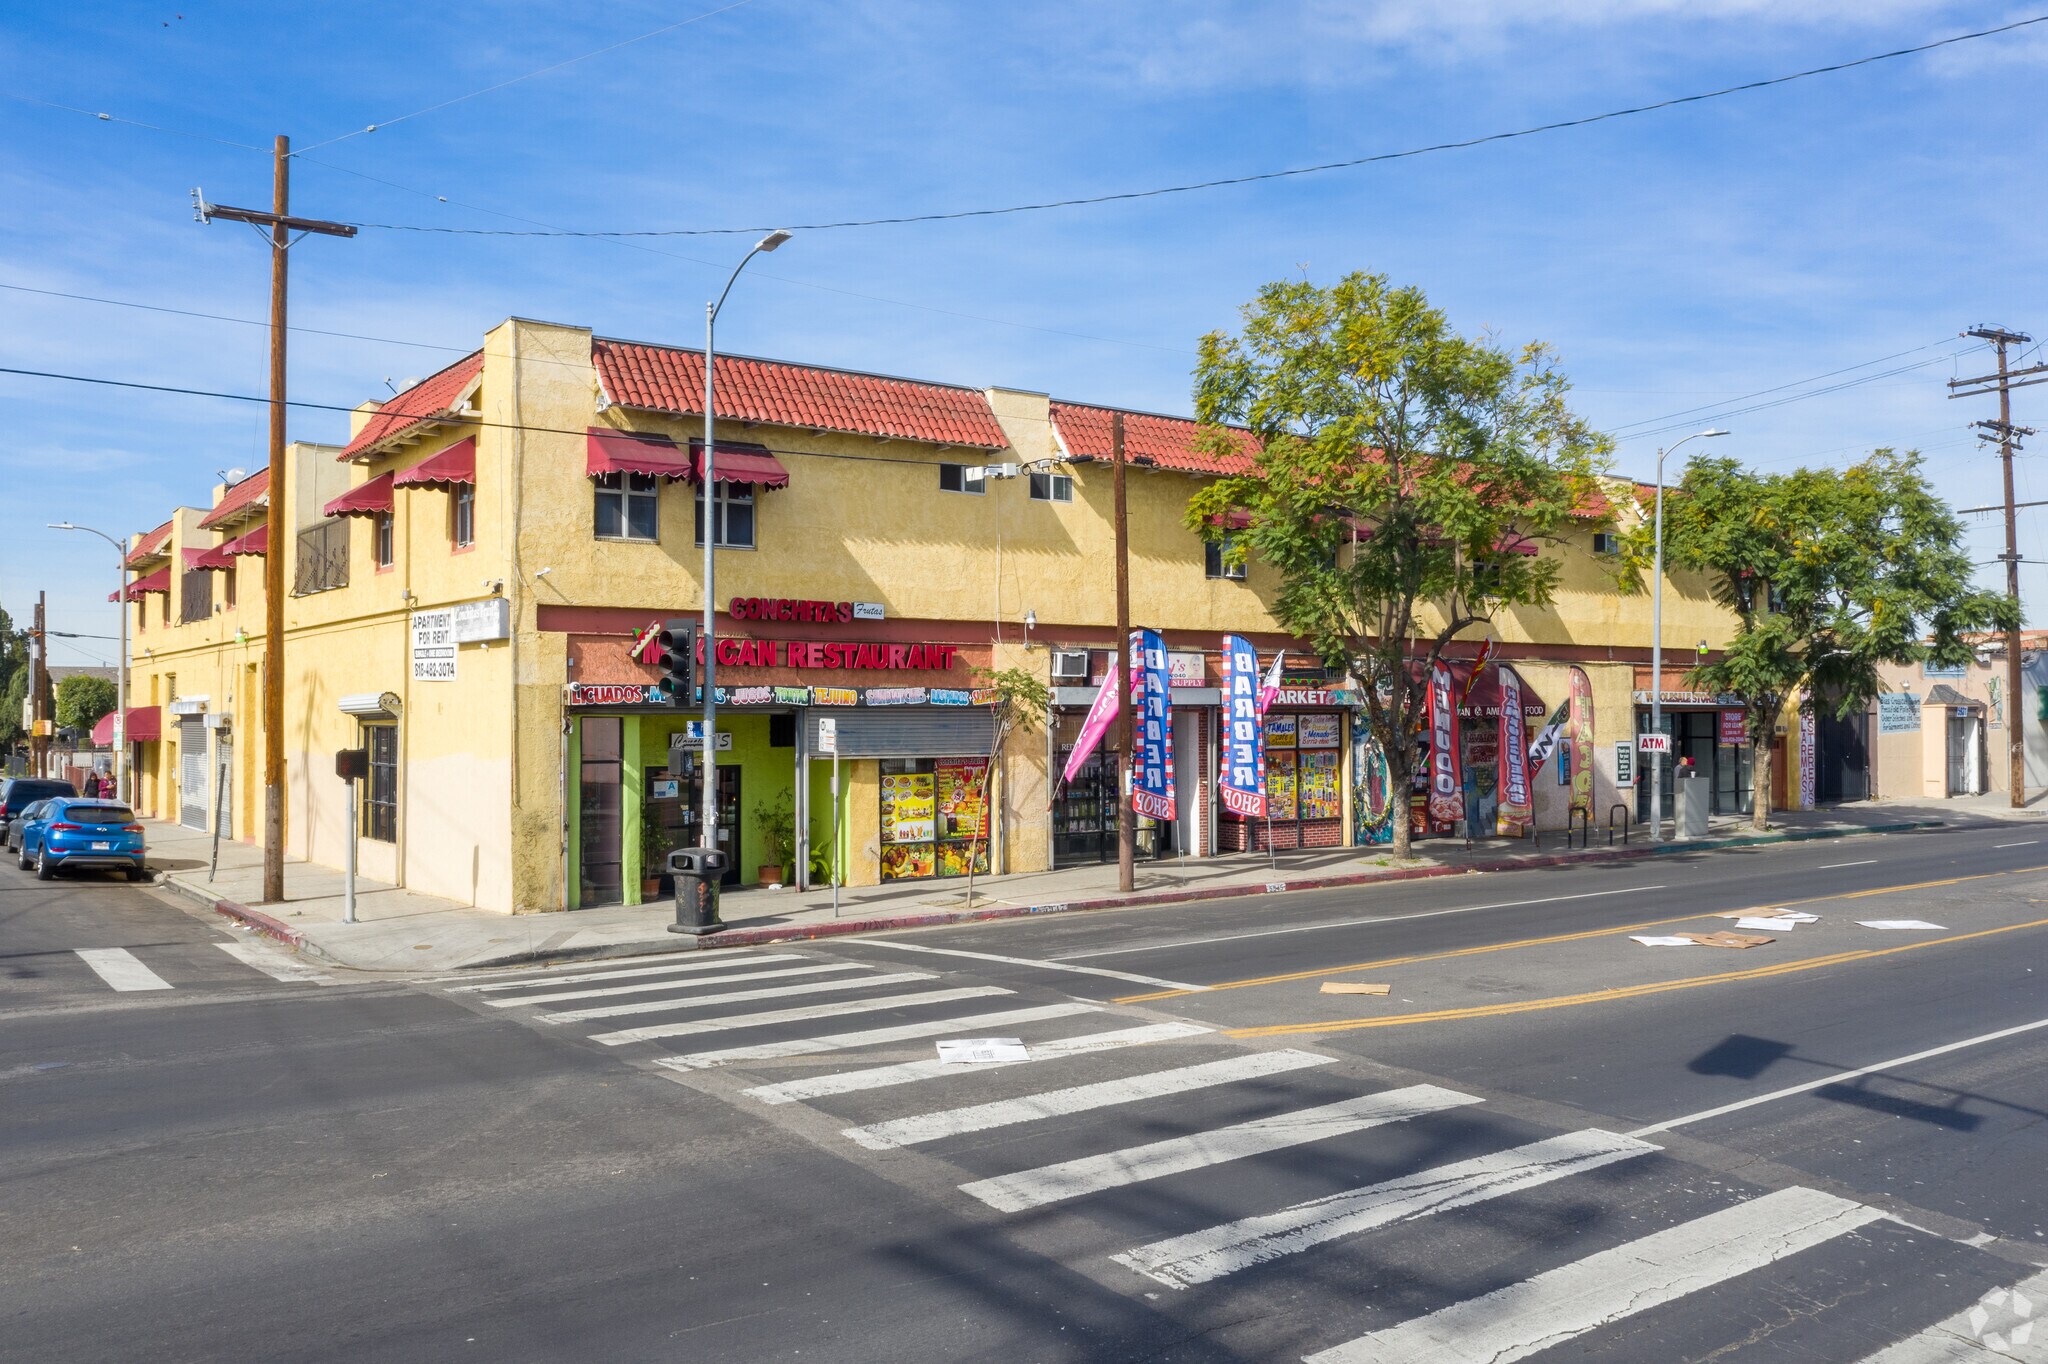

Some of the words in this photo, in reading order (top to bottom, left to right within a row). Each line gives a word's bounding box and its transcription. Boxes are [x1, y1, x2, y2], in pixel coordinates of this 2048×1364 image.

[729, 597, 852, 623] CONCHITAS
[856, 603, 883, 617] Frutas
[413, 613, 451, 629] APARTMENT
[418, 631, 430, 645] FOR
[433, 630, 449, 644] RENT
[642, 639, 777, 667] MXCAN
[787, 642, 958, 669] RESTAURANT
[1172, 679, 1203, 687] SUPPLY
[571, 685, 643, 706] LICUADOS
[731, 685, 771, 705] JUGOS
[774, 686, 809, 706] TORTAS
[814, 687, 857, 706] TEJUINO
[865, 687, 926, 706] SANDWICHES
[930, 688, 969, 706] RASPADOS
[1272, 690, 1326, 704] ARKET
[1645, 692, 1691, 704] WOLESALE
[1525, 705, 1544, 715] FOOD
[1725, 712, 1741, 720] STORE
[1267, 723, 1294, 733] TAMALES
[1641, 738, 1665, 749] ATM
